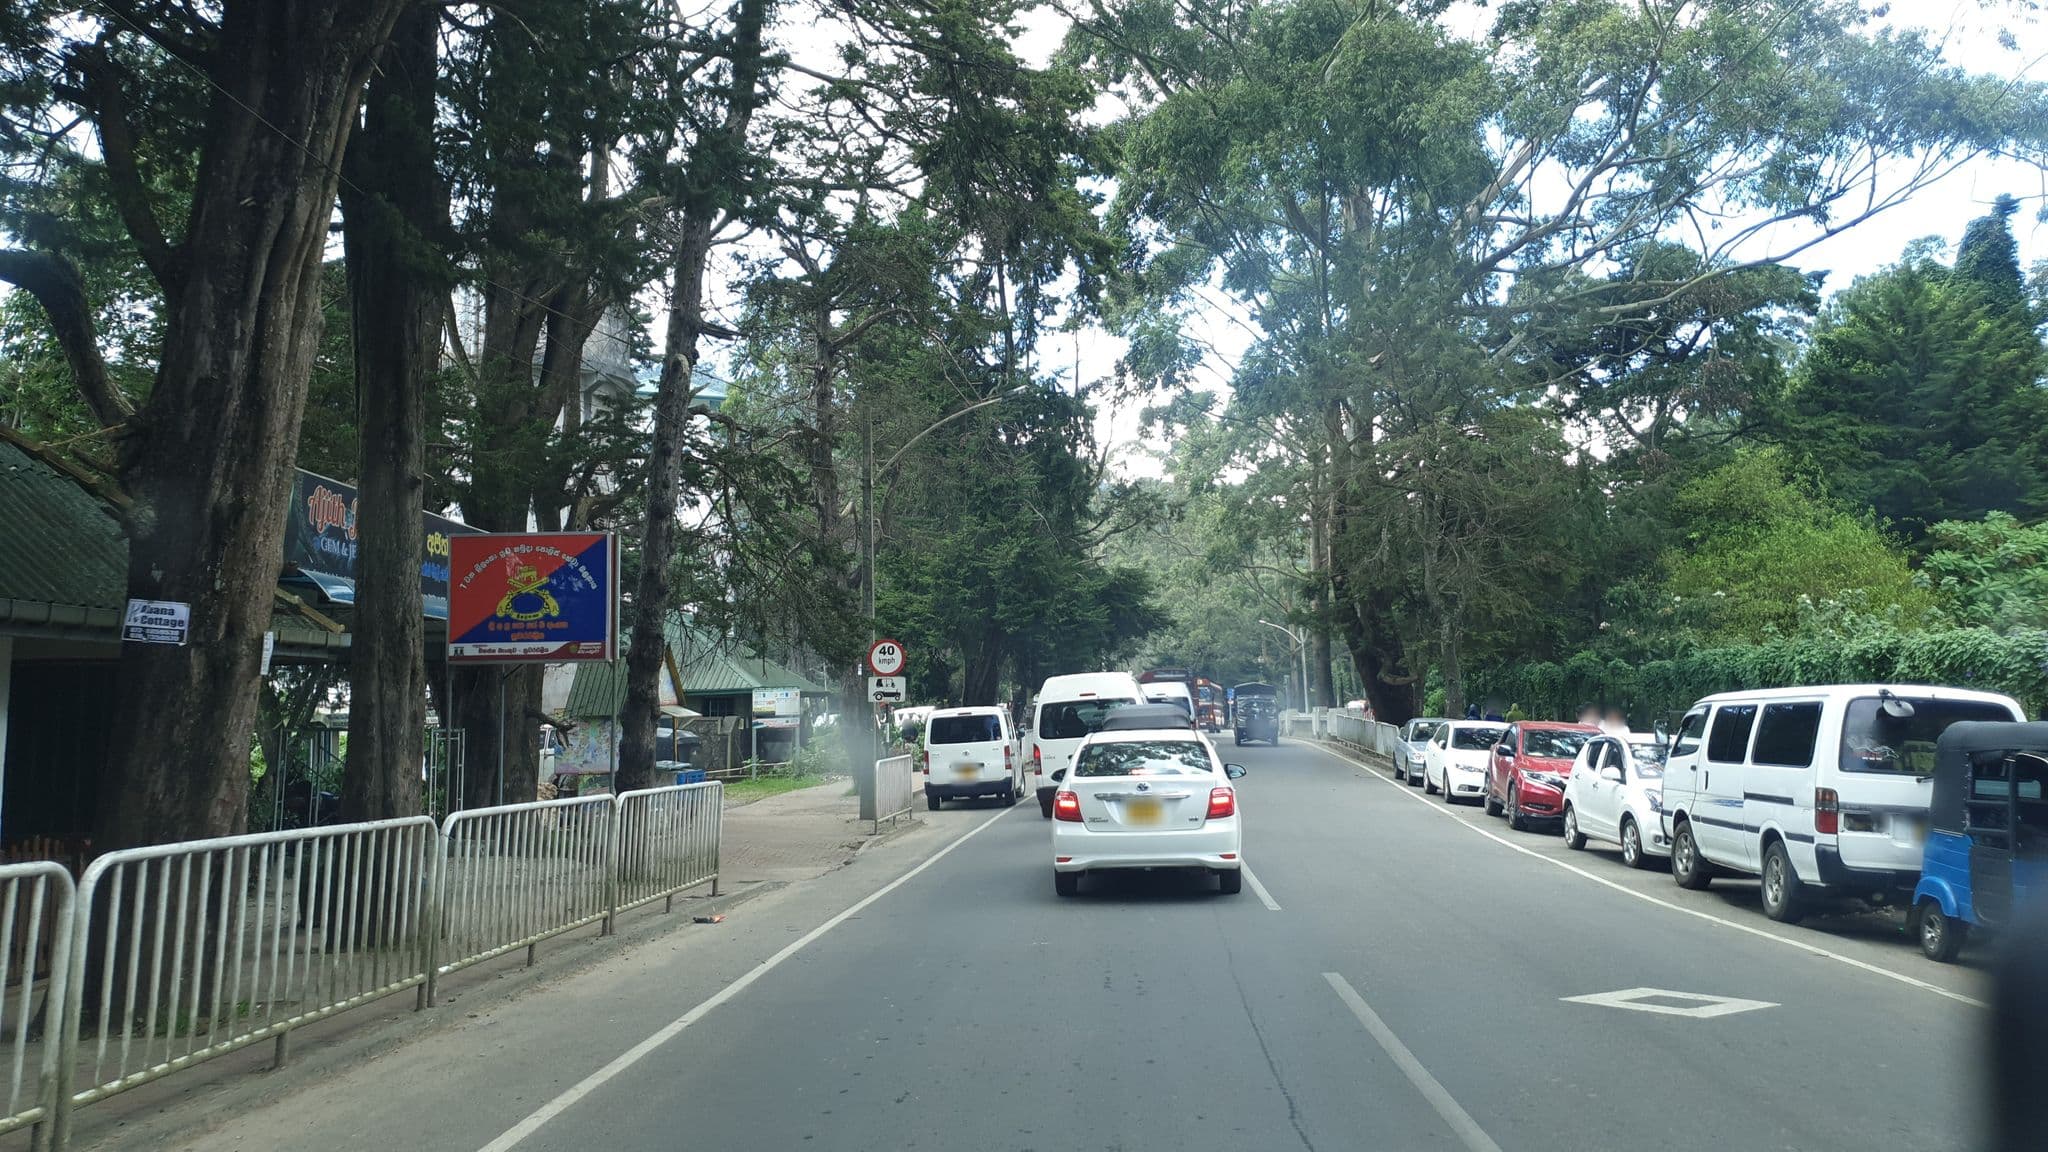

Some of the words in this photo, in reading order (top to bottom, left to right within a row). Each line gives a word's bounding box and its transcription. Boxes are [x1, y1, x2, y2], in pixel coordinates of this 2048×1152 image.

[308, 485, 346, 533] Ajith
[320, 536, 340, 555] GEM
[341, 543, 349, 556] &
[140, 615, 184, 628] Cottage
[878, 645, 895, 656] 40
[878, 657, 896, 666] kmph
